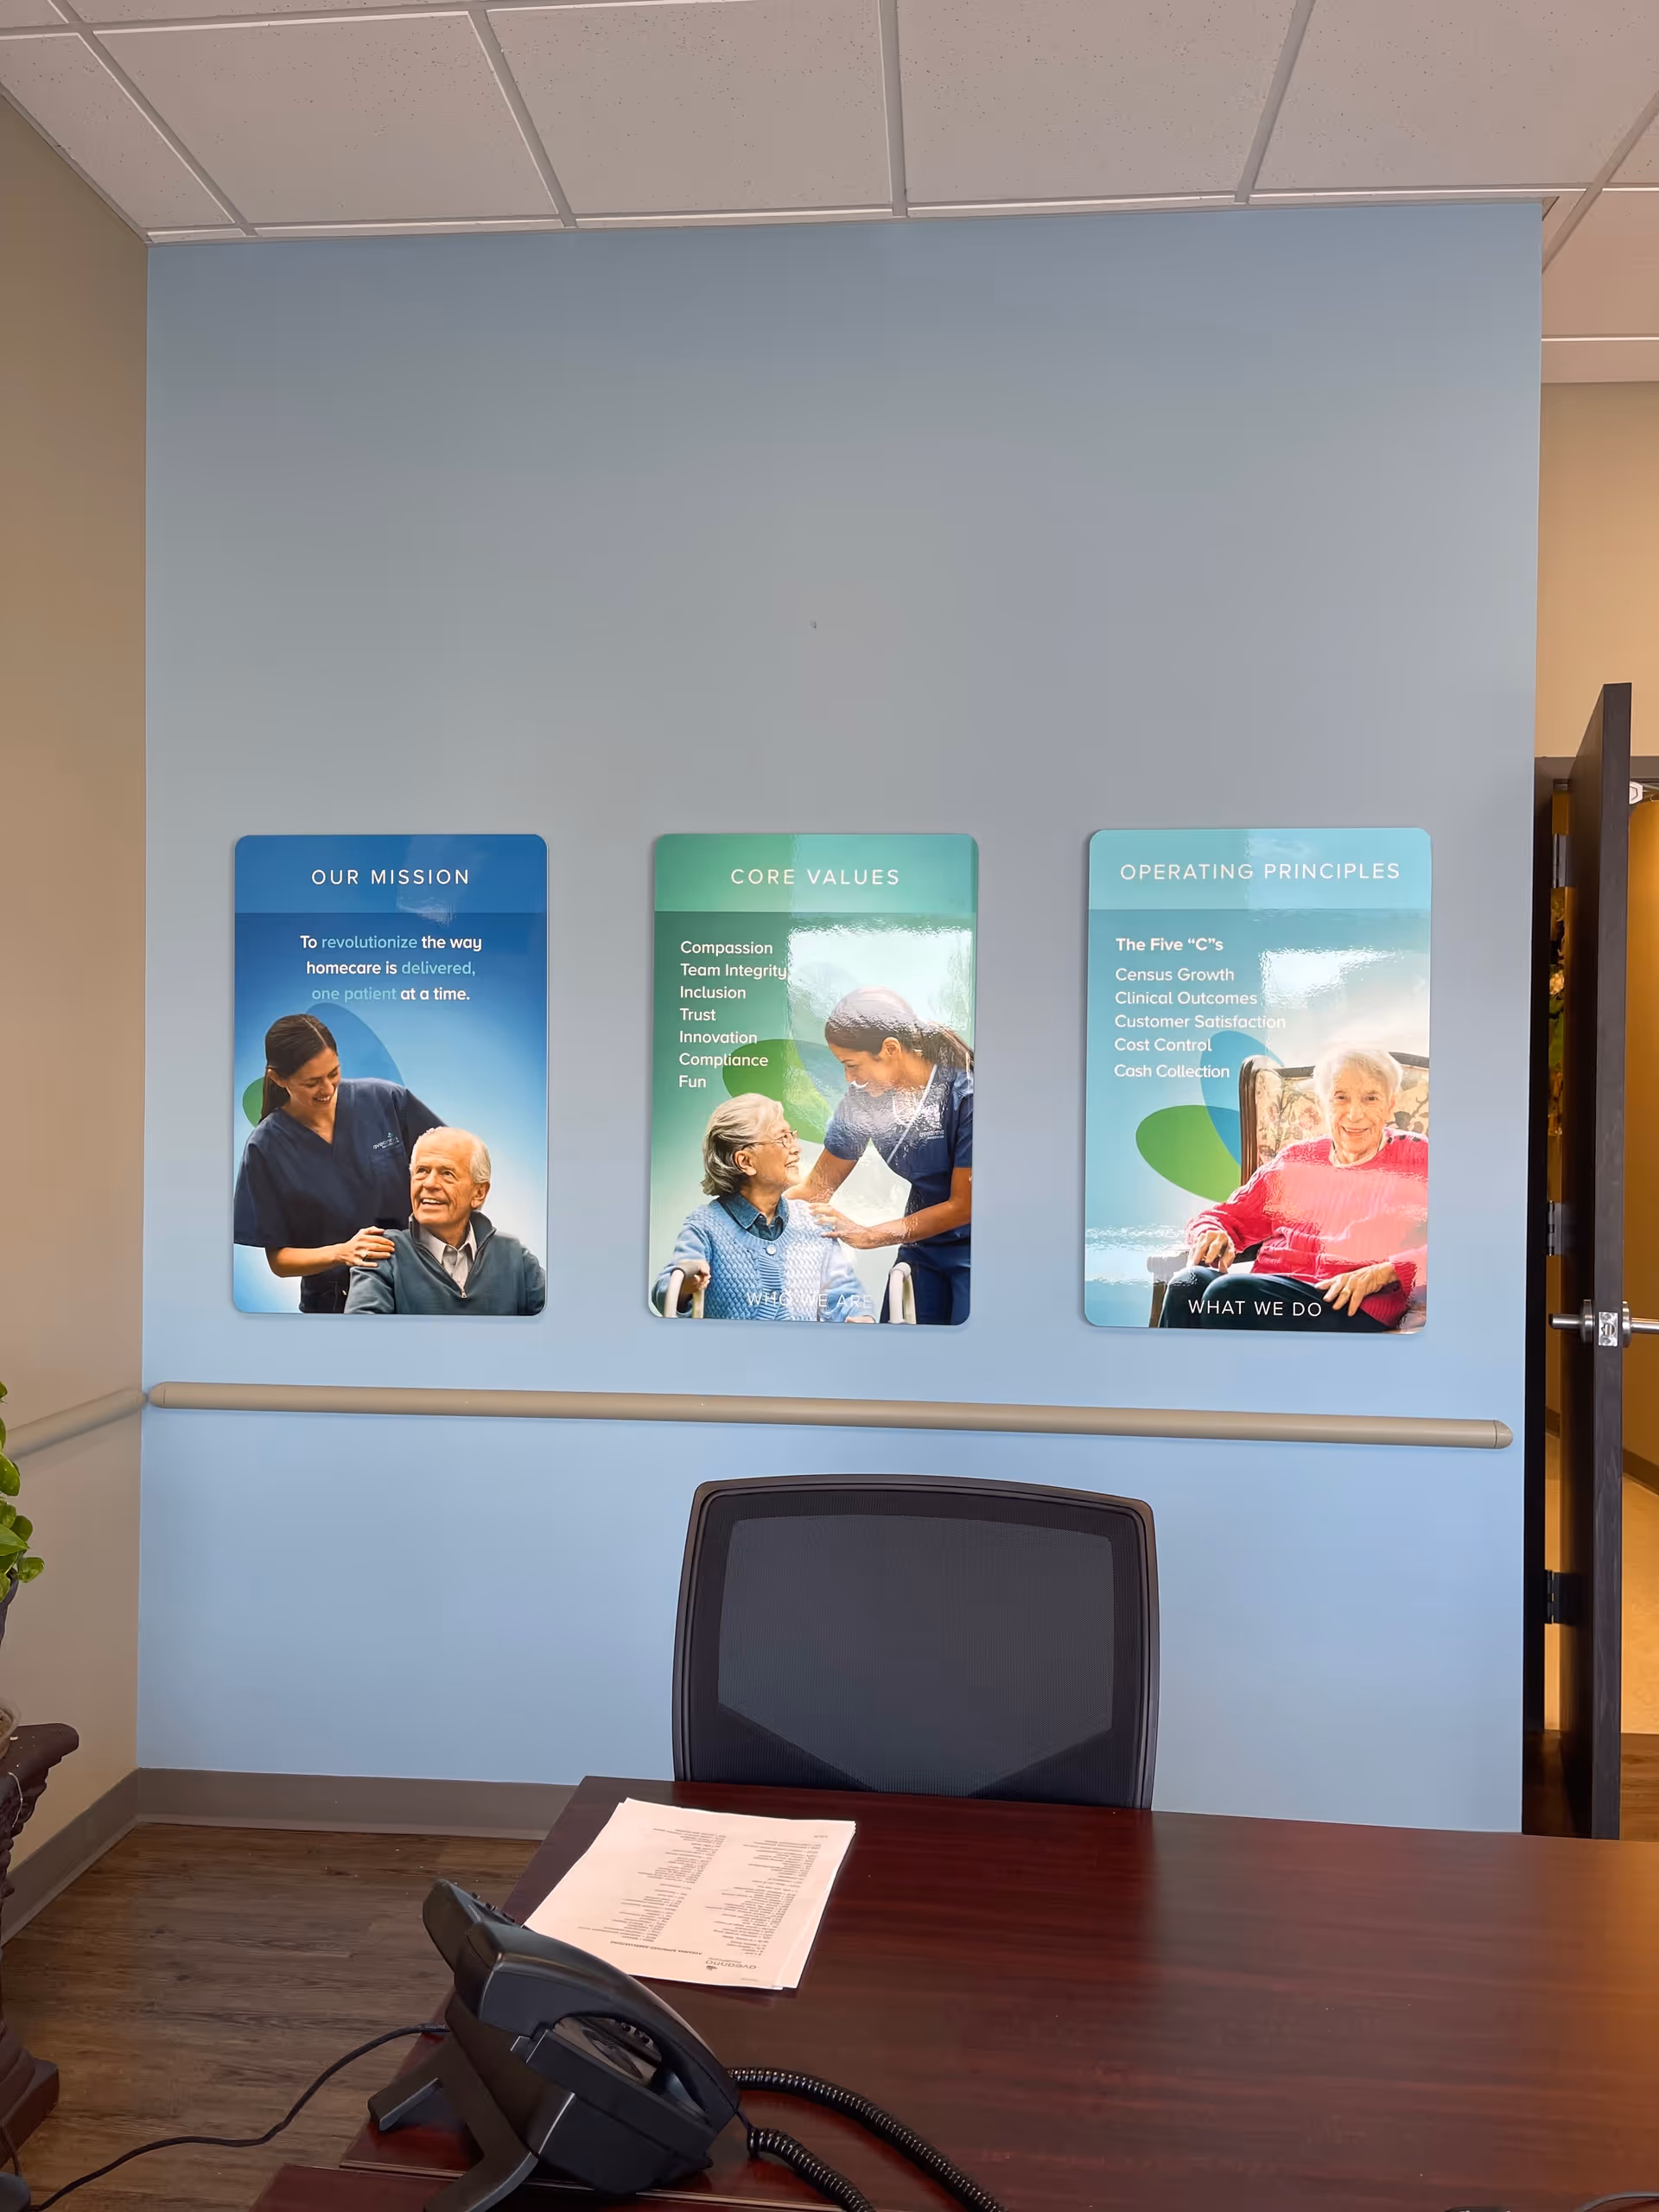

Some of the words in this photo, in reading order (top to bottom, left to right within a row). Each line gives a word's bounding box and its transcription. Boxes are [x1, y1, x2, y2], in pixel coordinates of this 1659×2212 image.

[311, 869, 359, 885] OUR
[371, 869, 470, 885] MISSION
[731, 868, 796, 886] CORE
[807, 869, 900, 886] VALUES
[1120, 863, 1254, 880] OPERATING
[1264, 862, 1401, 880] PRINCIPLES
[300, 935, 318, 949] To
[321, 935, 417, 949] revolutionize
[422, 935, 446, 949] the
[450, 938, 482, 952] way
[680, 940, 773, 957] Compassion
[1116, 938, 1146, 952] The
[1150, 938, 1184, 952] Five
[306, 962, 382, 976] homecare
[385, 962, 397, 976] is
[401, 962, 476, 977] delivered,
[680, 963, 721, 977] Team
[725, 963, 787, 981] Integrity
[1115, 968, 1173, 982] Census
[1177, 968, 1235, 982] Growth
[312, 988, 340, 1001] one
[344, 987, 397, 1003] patient
[400, 988, 416, 1001] at
[419, 989, 429, 1001] a
[433, 987, 471, 1001] time.
[679, 985, 747, 1000] Inclusion
[1115, 991, 1173, 1006] Clinical
[1177, 991, 1258, 1006] Outcomes
[679, 1007, 716, 1022] Trust
[1115, 1014, 1190, 1029] Customer
[1194, 1014, 1286, 1029] Satisfaction
[678, 1030, 758, 1045] Innovation
[1114, 1038, 1150, 1052] Cost
[1154, 1038, 1212, 1052] Control
[678, 1052, 769, 1069] Compliance
[1114, 1064, 1152, 1078] Cash
[1155, 1064, 1230, 1079] Collection
[678, 1075, 707, 1089] Fun
[746, 1292, 792, 1306] WHO
[801, 1293, 828, 1307] WE
[836, 1294, 873, 1308] ARE
[1188, 1299, 1246, 1315] WHAT
[1254, 1300, 1284, 1316] WE
[1292, 1301, 1322, 1317] DO
[705, 1960, 757, 1970] aveanna
